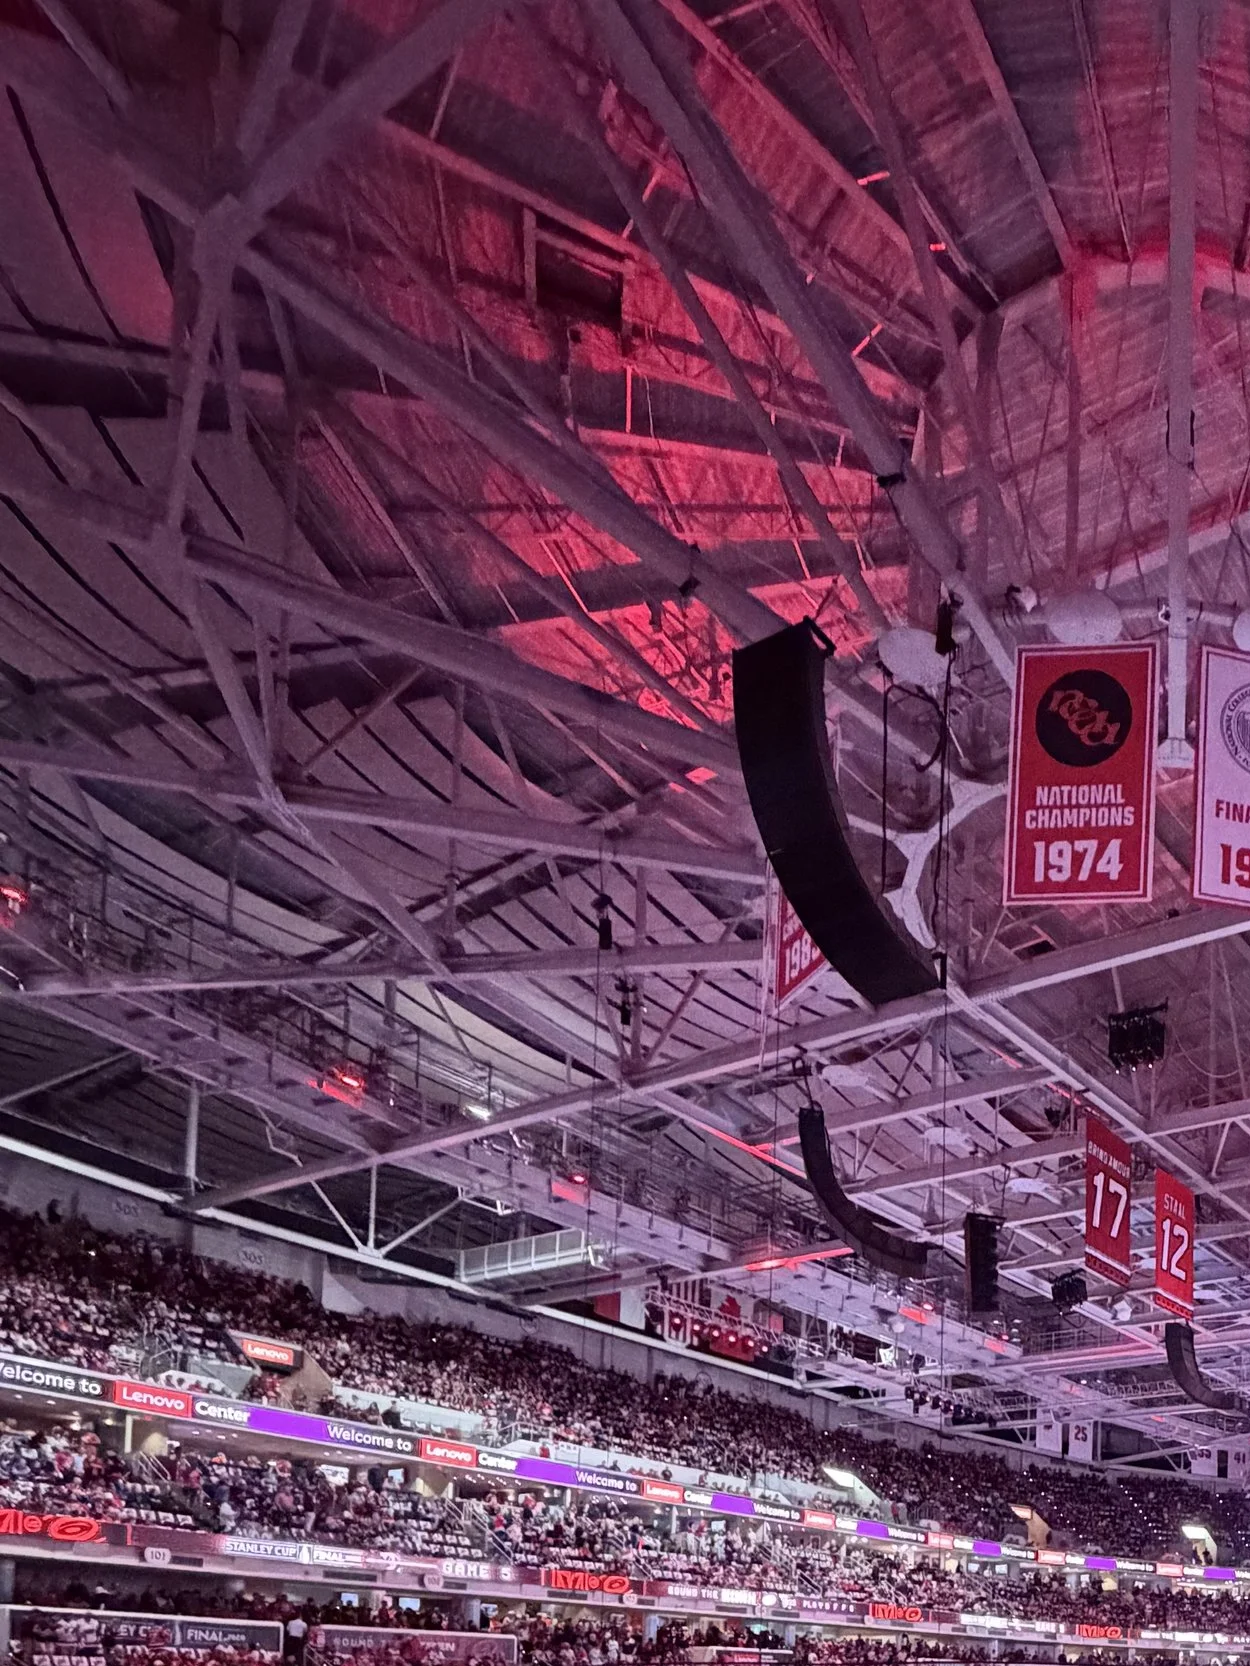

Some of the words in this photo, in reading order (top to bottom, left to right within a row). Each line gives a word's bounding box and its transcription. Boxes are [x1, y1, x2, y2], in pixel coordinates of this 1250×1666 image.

[1036, 785, 1125, 806] NATIONAL
[1025, 806, 1135, 830] CHAMPIONS
[1033, 839, 1124, 883] 1974
[1092, 1171, 1128, 1239] 17
[1164, 1193, 1186, 1220] STAAL
[1161, 1218, 1190, 1281] 12
[246, 1341, 292, 1363] Lenovo
[78, 1378, 103, 1397] to
[122, 1386, 186, 1411] Lenovo
[194, 1398, 251, 1423] Center
[326, 1423, 394, 1448] Welcome
[396, 1437, 412, 1452] to
[426, 1443, 472, 1463] Lenovo
[1074, 1425, 1088, 1442] 25
[575, 1470, 623, 1490] Welcome
[625, 1480, 637, 1493] to
[225, 1541, 273, 1555] STANLEY
[275, 1543, 297, 1557] CUP
[313, 1551, 344, 1562] FINAL
[441, 1561, 490, 1578] GAME
[187, 1628, 222, 1642] FINAL
